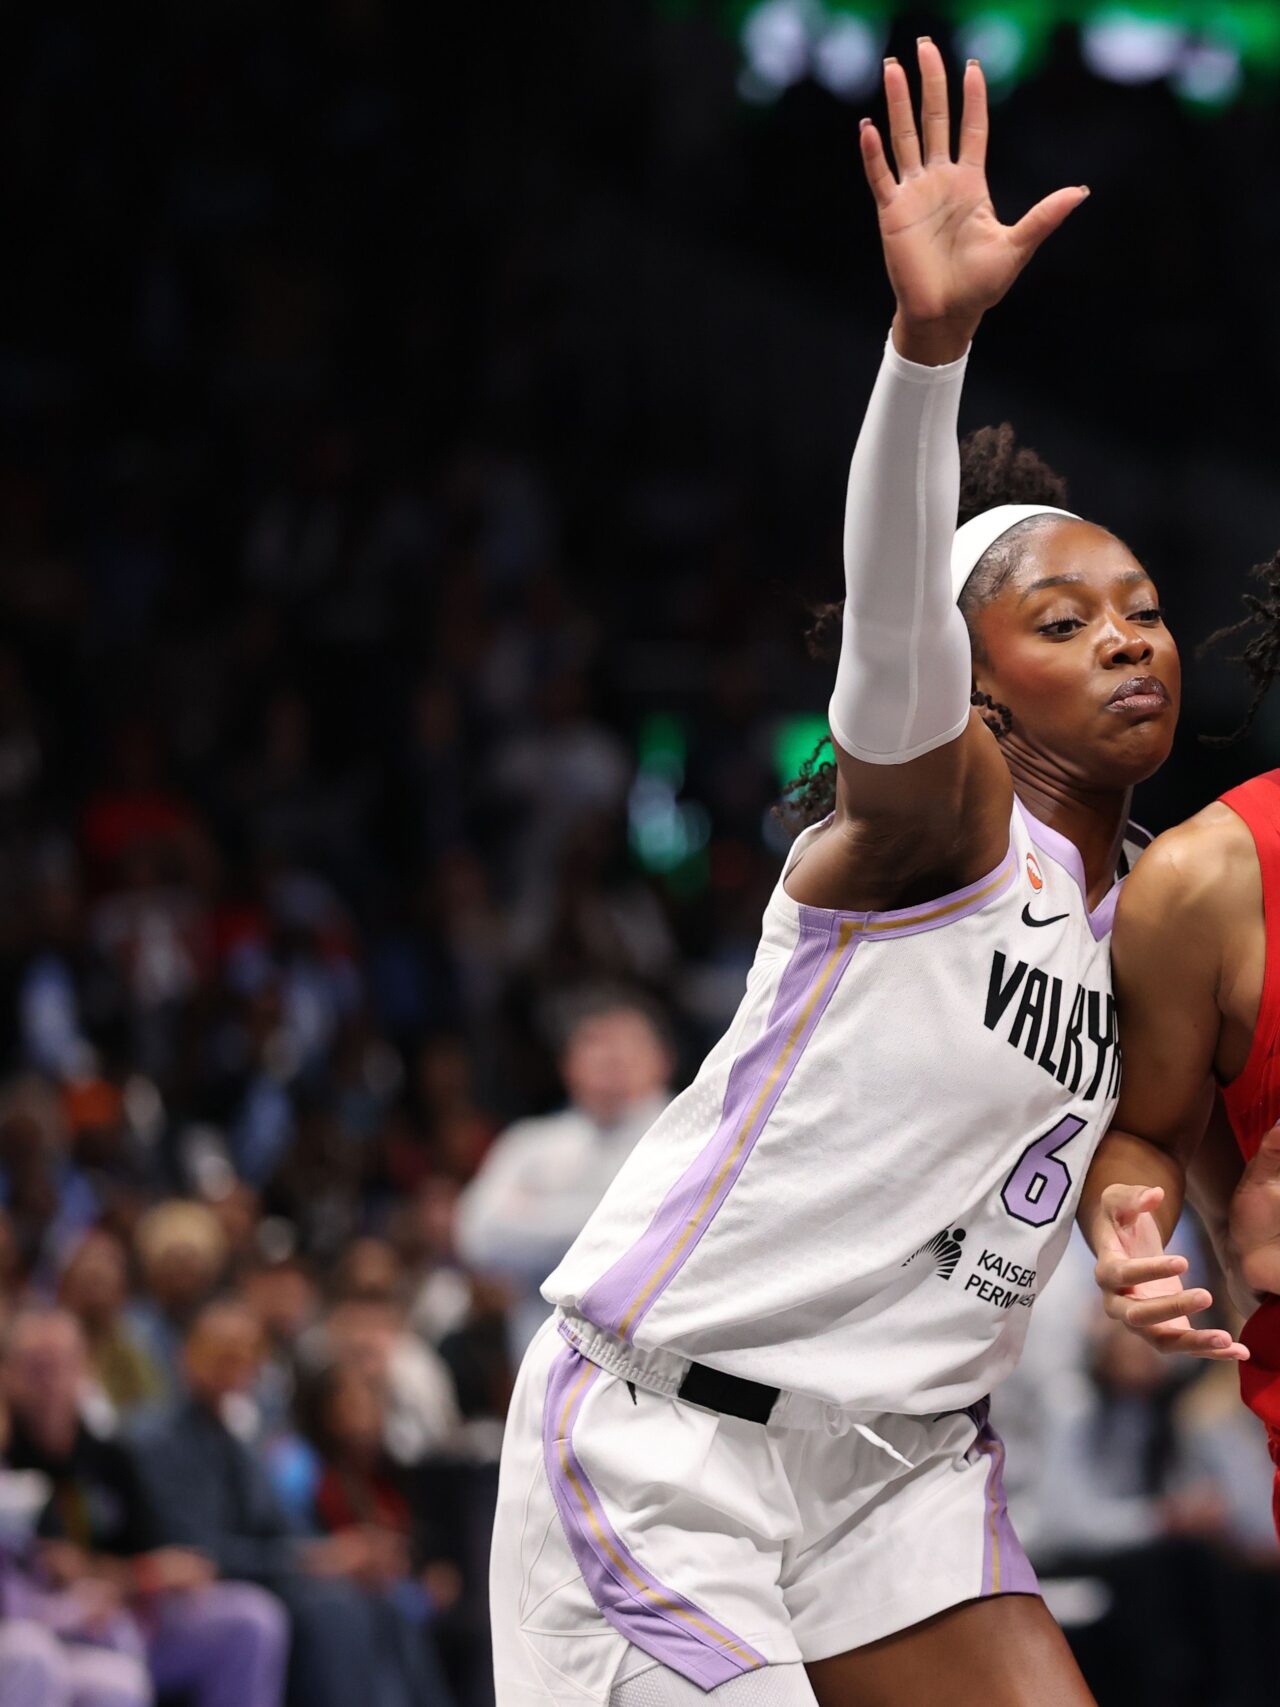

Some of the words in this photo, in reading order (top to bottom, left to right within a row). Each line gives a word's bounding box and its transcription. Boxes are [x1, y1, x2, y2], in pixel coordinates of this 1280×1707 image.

[983, 950, 1122, 1101] VALKYR
[1000, 1112, 1088, 1229] 6
[977, 1249, 1037, 1288] KAISER
